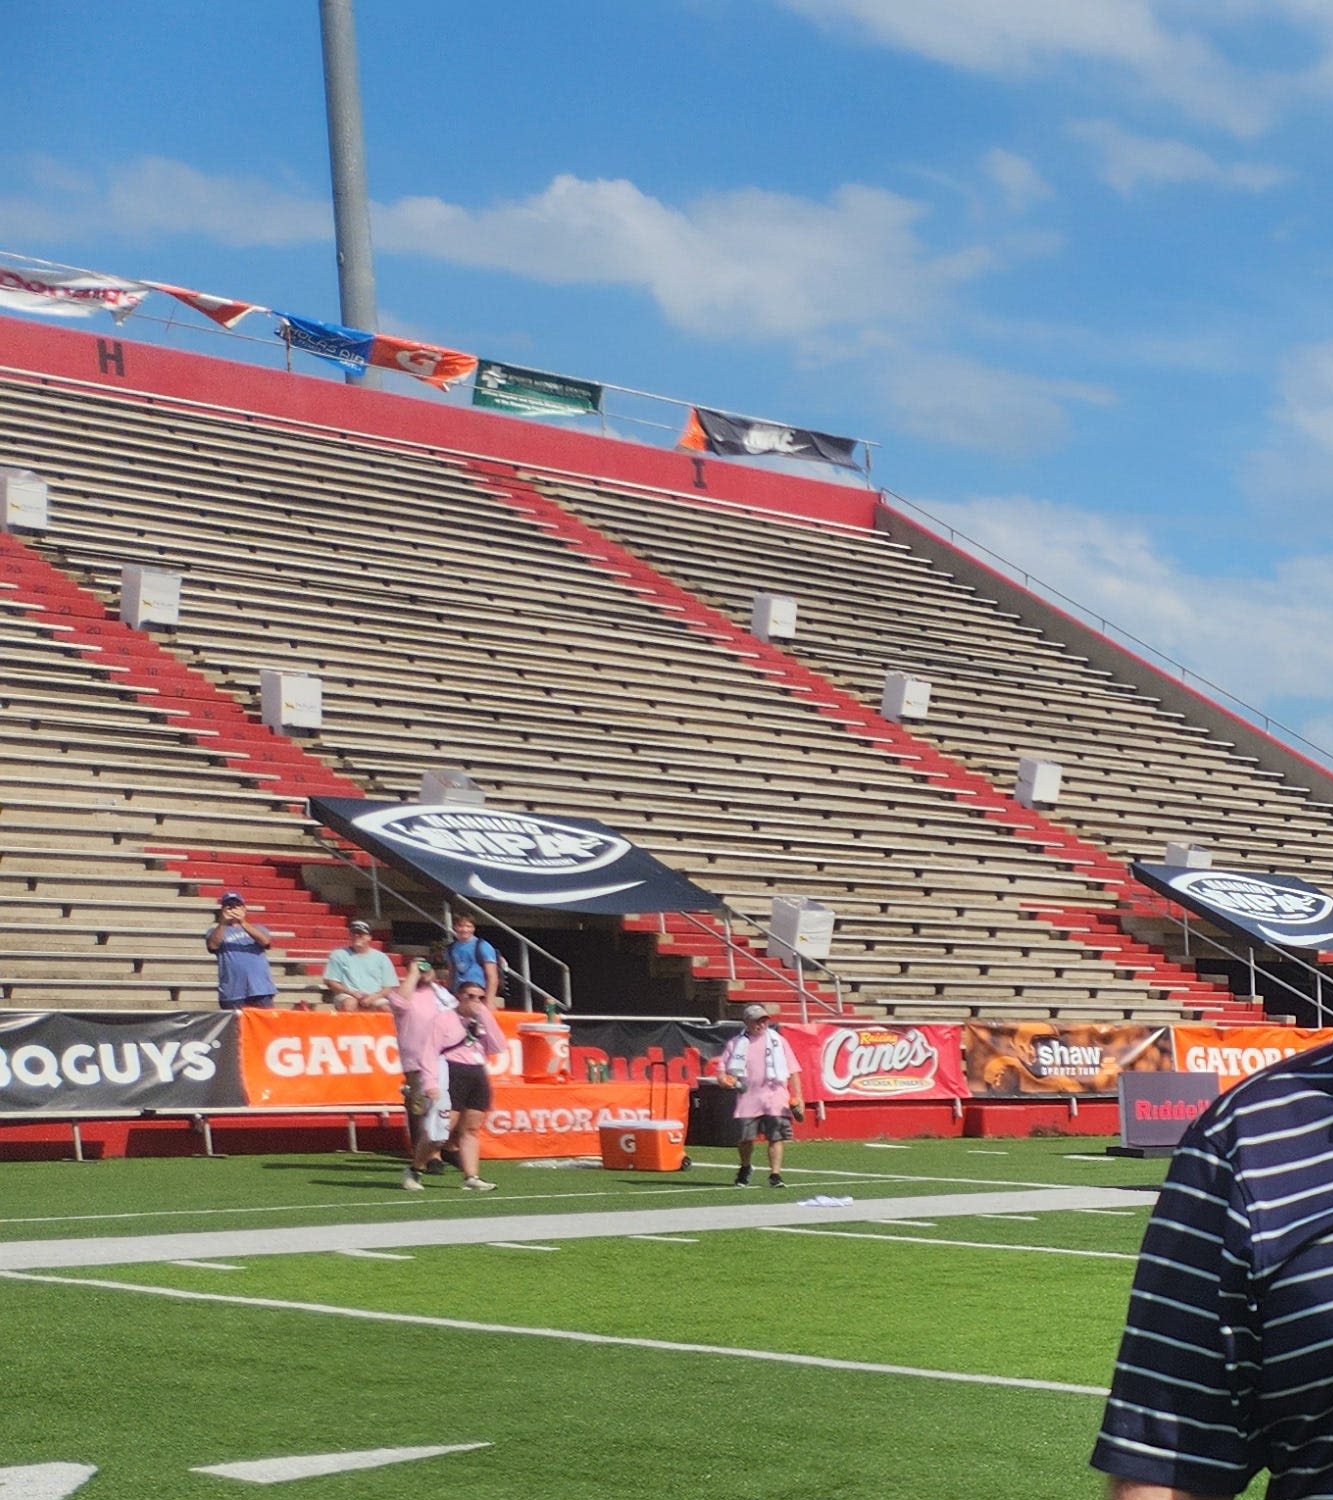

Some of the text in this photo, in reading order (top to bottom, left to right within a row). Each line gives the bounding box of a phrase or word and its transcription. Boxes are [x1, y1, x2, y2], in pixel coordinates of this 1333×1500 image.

[97, 338, 125, 377] H
[396, 350, 442, 376] G
[692, 457, 708, 489] I
[859, 1031, 898, 1045] Raising
[823, 1028, 932, 1089] Cane's
[1038, 1040, 1102, 1066] shaw
[1041, 1067, 1101, 1076] SPORTS TURF
[620, 1134, 637, 1153] G
